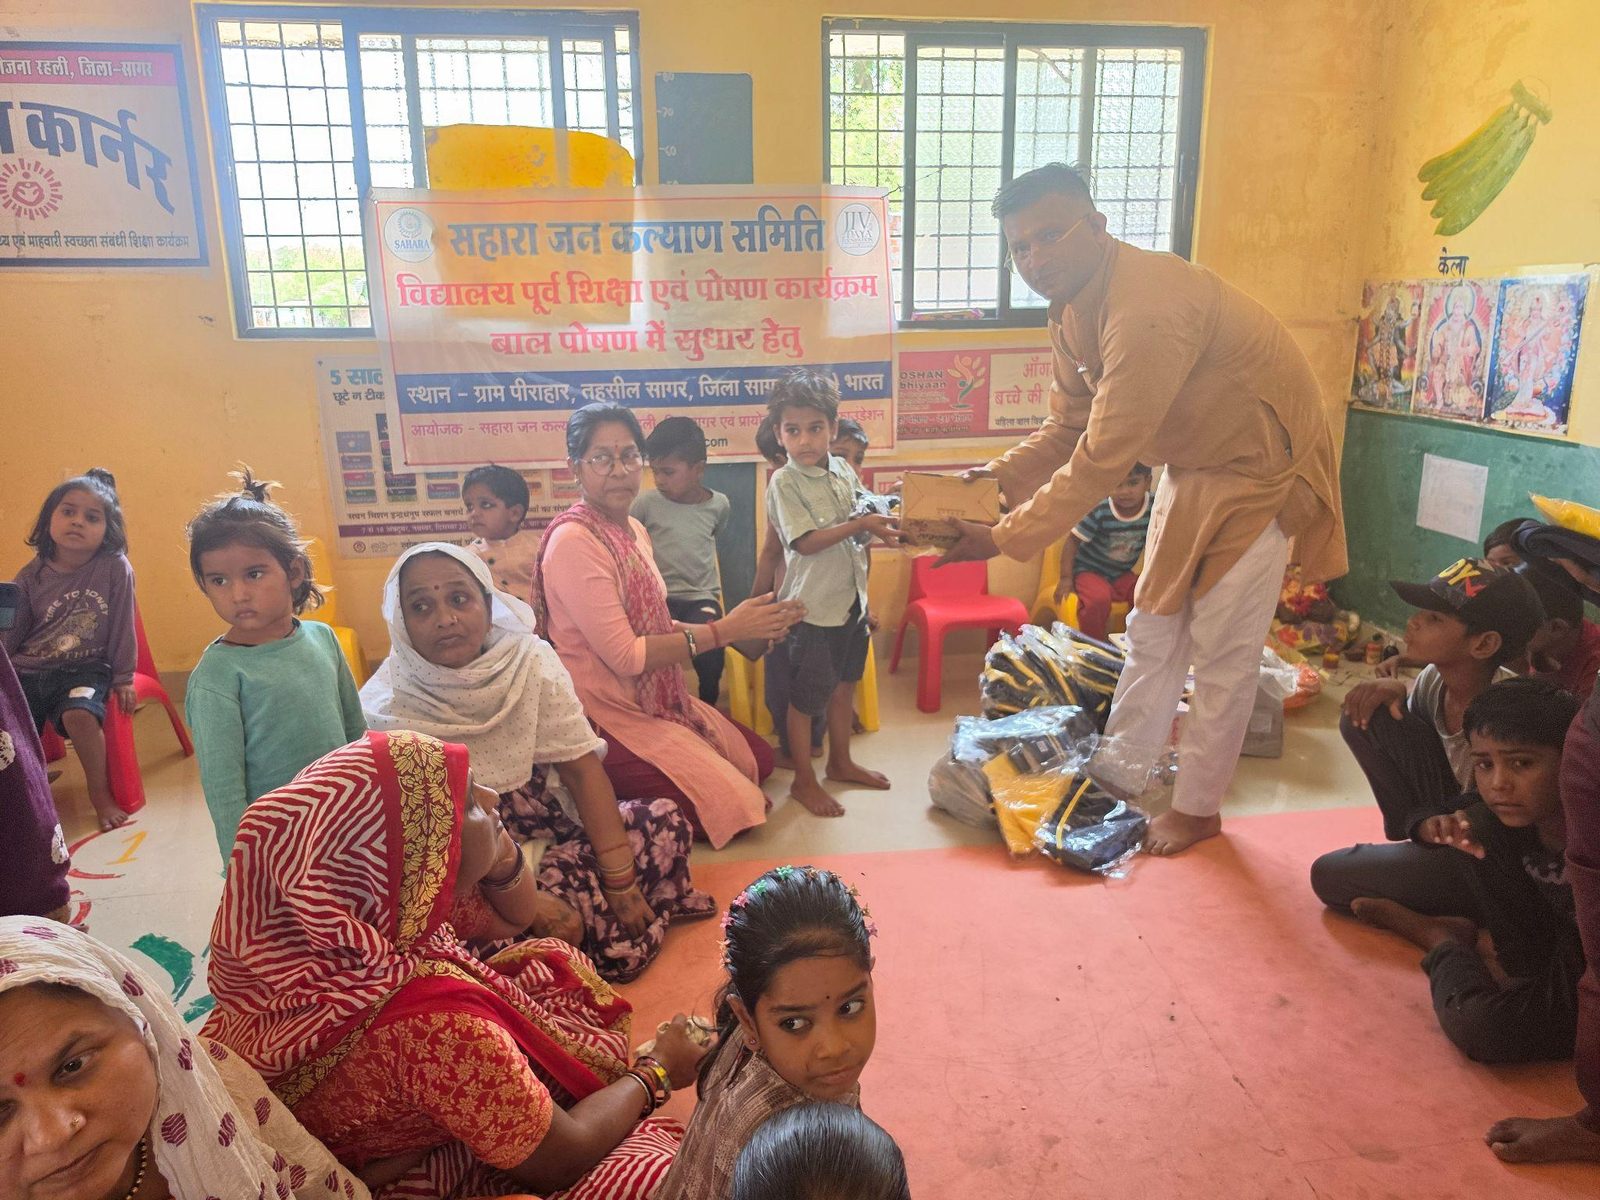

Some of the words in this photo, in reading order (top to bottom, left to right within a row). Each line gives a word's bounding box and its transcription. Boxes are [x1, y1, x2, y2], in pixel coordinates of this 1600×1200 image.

[35, 56, 74, 79] रहली,
[20, 101, 175, 216] कार्नर
[128, 230, 153, 248] शिक्षा
[394, 239, 430, 249] SAHARA
[448, 222, 540, 262] सहारा
[546, 222, 601, 255] जन
[609, 220, 724, 255] कल्याण
[730, 204, 826, 253] समिति
[396, 273, 516, 307] विद्यालय
[521, 271, 560, 315] पूर्व
[566, 270, 643, 307] शिक्षा
[649, 270, 689, 310] एवं
[696, 269, 768, 302] पोषण
[774, 267, 878, 302] कार्यक्रम
[490, 332, 552, 355] बाल
[558, 320, 638, 354] पोषण
[645, 320, 667, 352] में
[674, 327, 754, 361] सुधार
[762, 317, 803, 358] हेतु
[330, 369, 342, 385] 5
[900, 370, 943, 380] OSHAN
[900, 381, 946, 391] bhiyaan
[406, 385, 451, 404] स्थान
[473, 384, 505, 404] ग्राम
[509, 377, 576, 405] पीराहार,
[581, 375, 641, 401] तहसील
[645, 381, 693, 402] सागर,
[698, 374, 740, 397] जिला
[744, 379, 779, 396] साग
[844, 374, 884, 391] भारत
[994, 385, 1022, 405] बच्चे
[1026, 383, 1044, 404] की
[411, 420, 463, 437] आयोजक
[479, 422, 513, 436] सहारा
[517, 421, 538, 433] जन
[720, 411, 735, 430] एवं
[105, 831, 147, 866] 1
